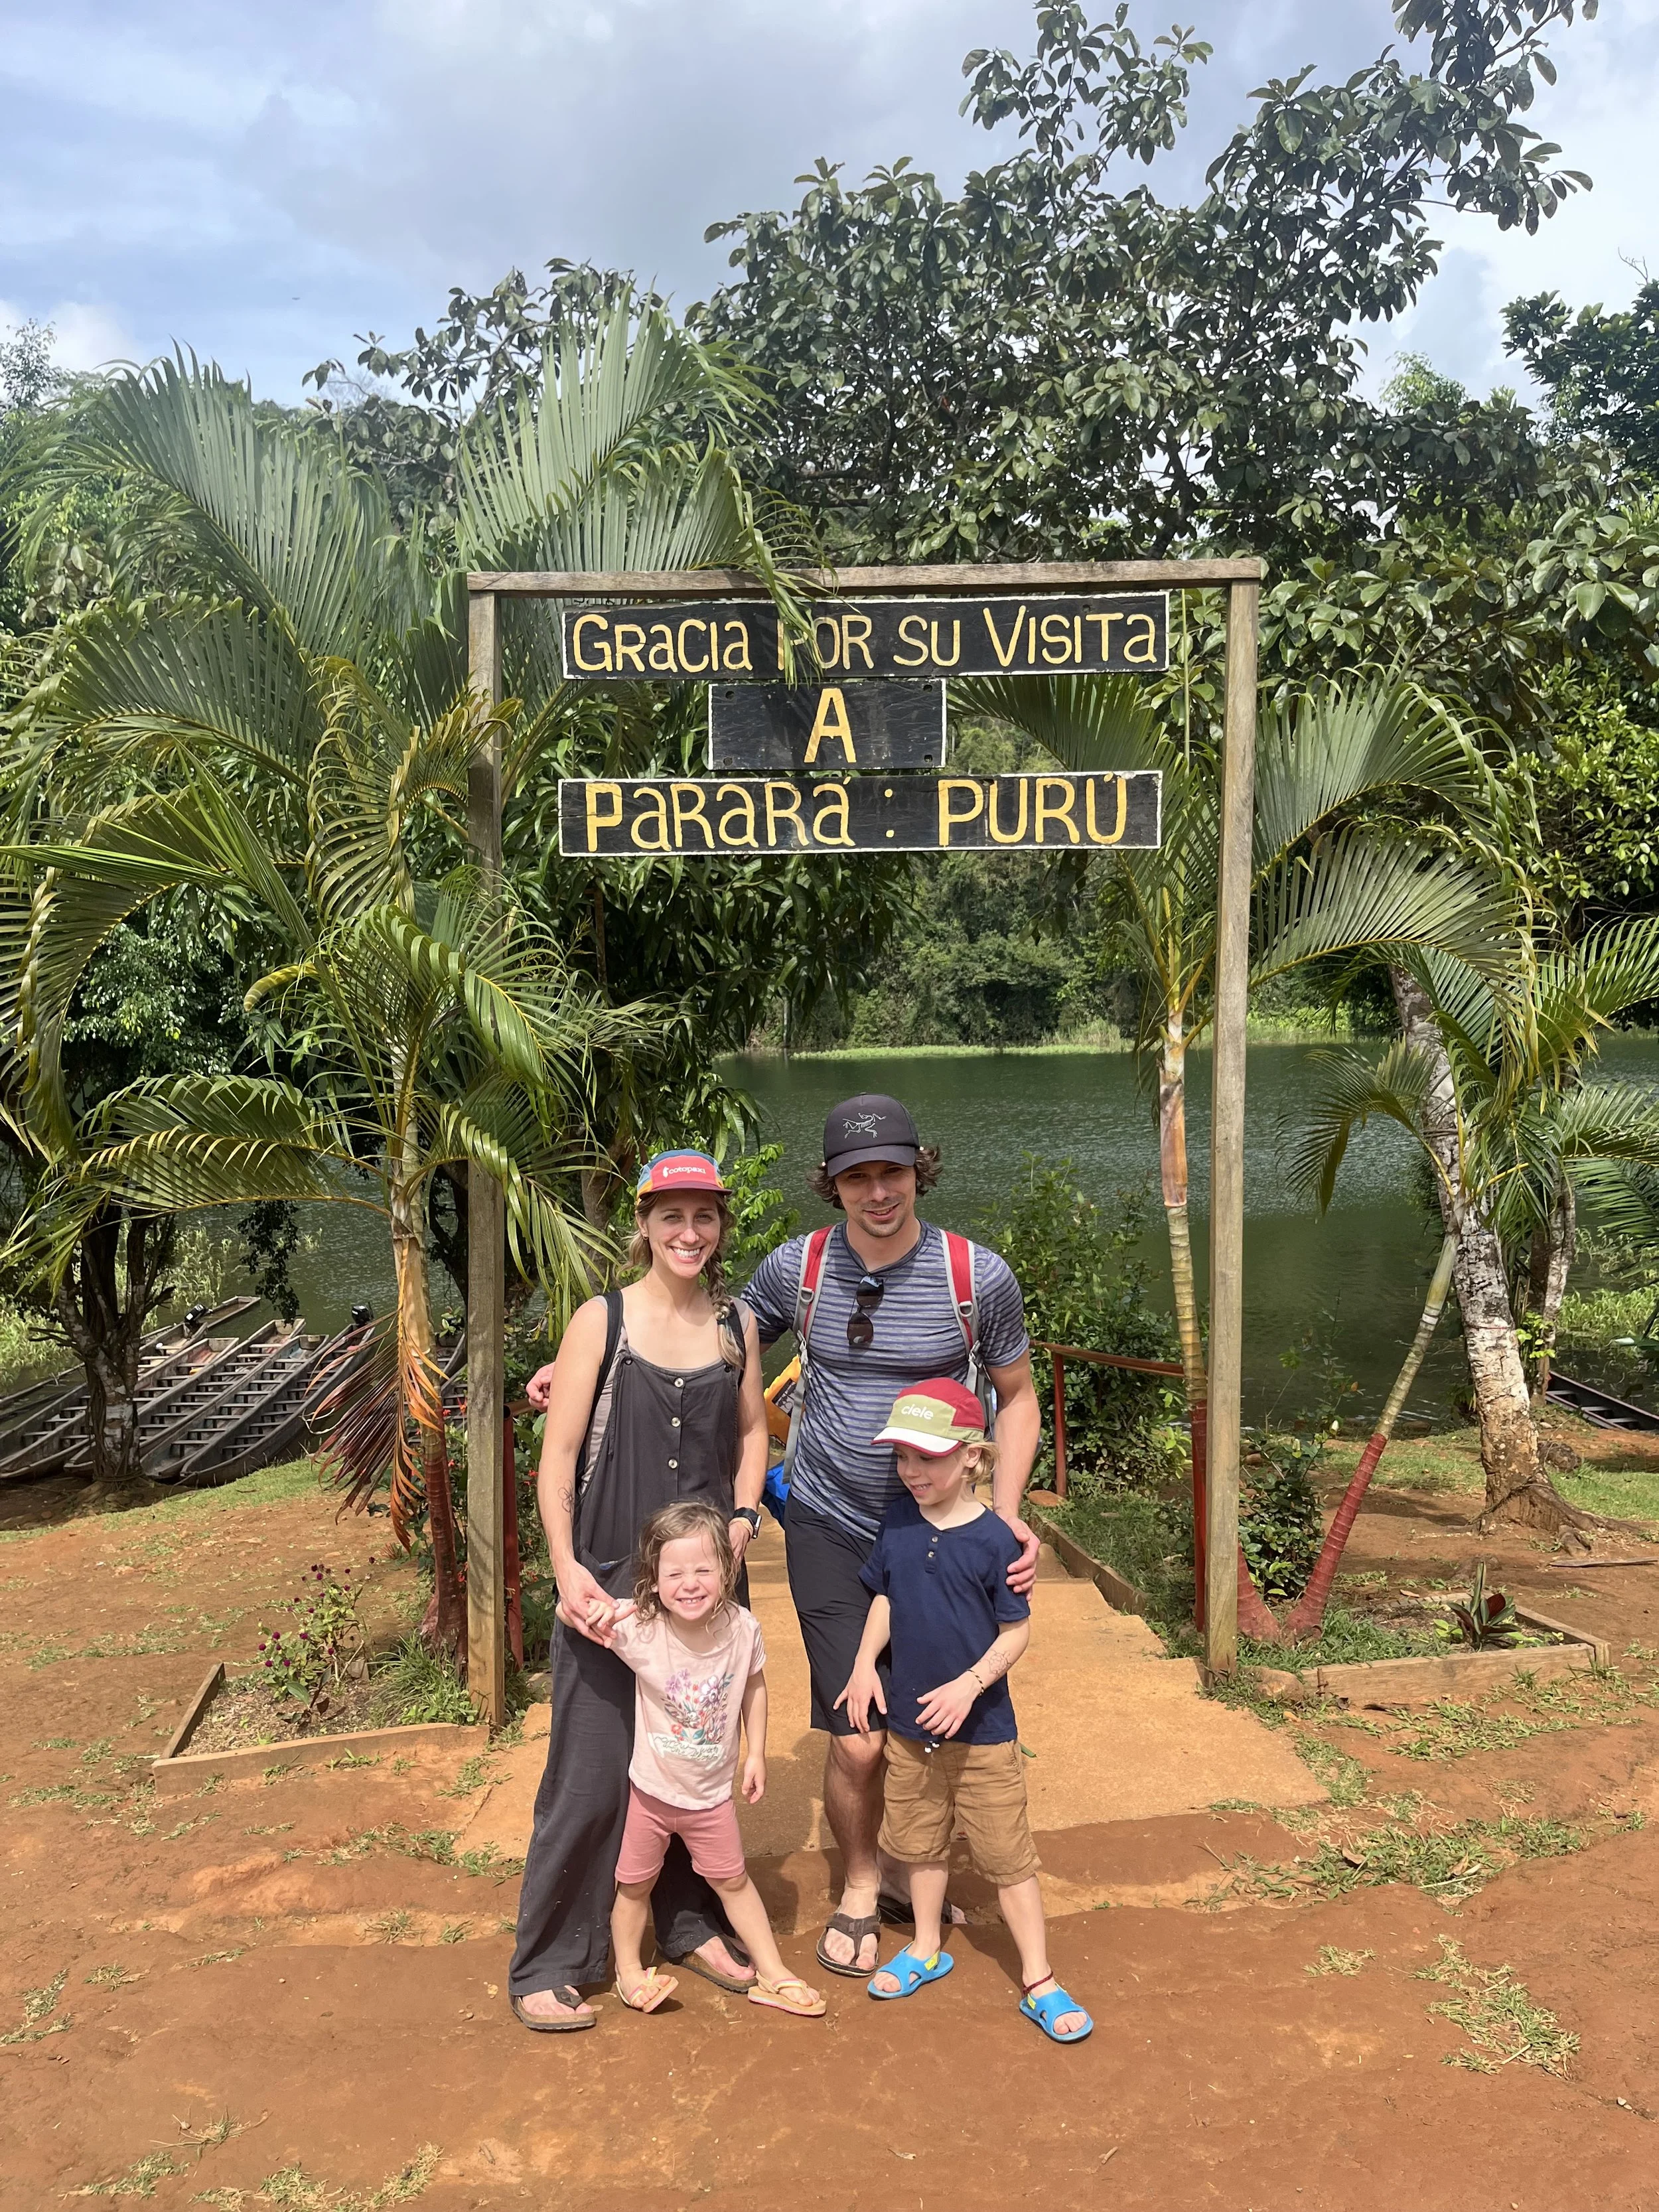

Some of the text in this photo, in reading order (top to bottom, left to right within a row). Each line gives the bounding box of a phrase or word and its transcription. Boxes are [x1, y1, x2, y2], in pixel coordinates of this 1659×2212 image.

[893, 615, 960, 667] SU
[804, 688, 857, 763] A
[901, 1404, 934, 1420] ciele
